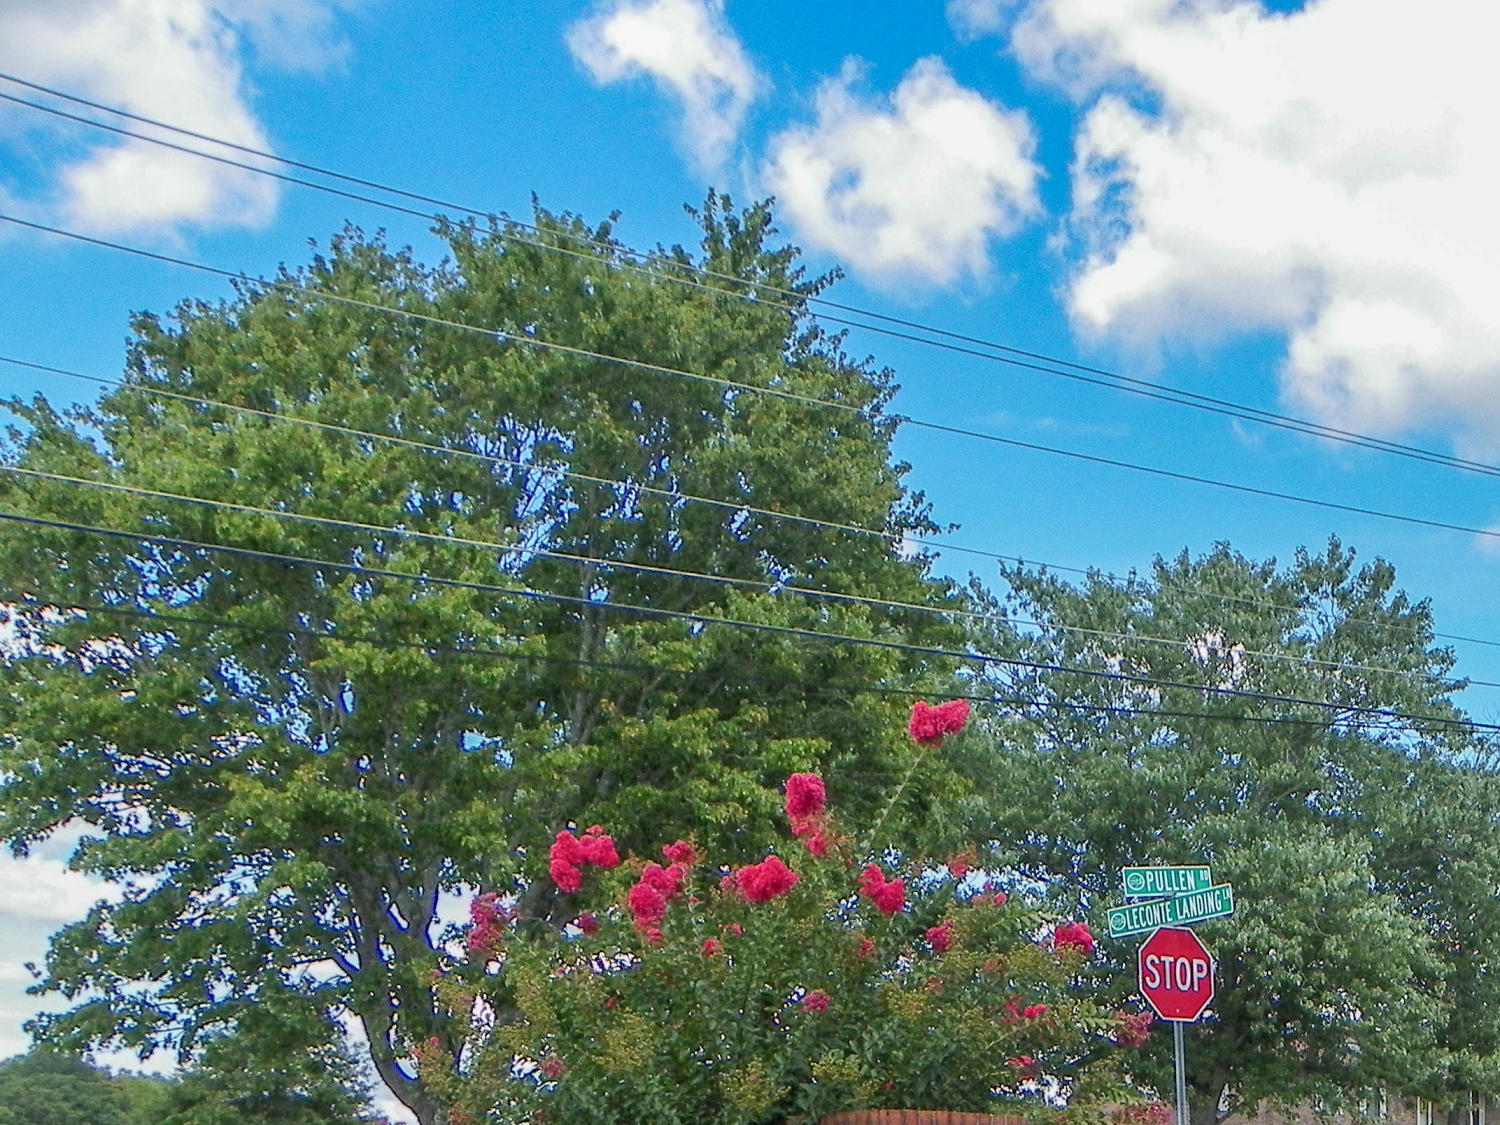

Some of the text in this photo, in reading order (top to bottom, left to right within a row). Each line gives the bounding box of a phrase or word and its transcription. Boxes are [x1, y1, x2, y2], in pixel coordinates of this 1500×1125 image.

[1146, 870, 1209, 892] PULLEN RD
[1125, 901, 1173, 930] LECONTE
[1175, 890, 1222, 920] LANDING
[1145, 954, 1208, 992] STOP
